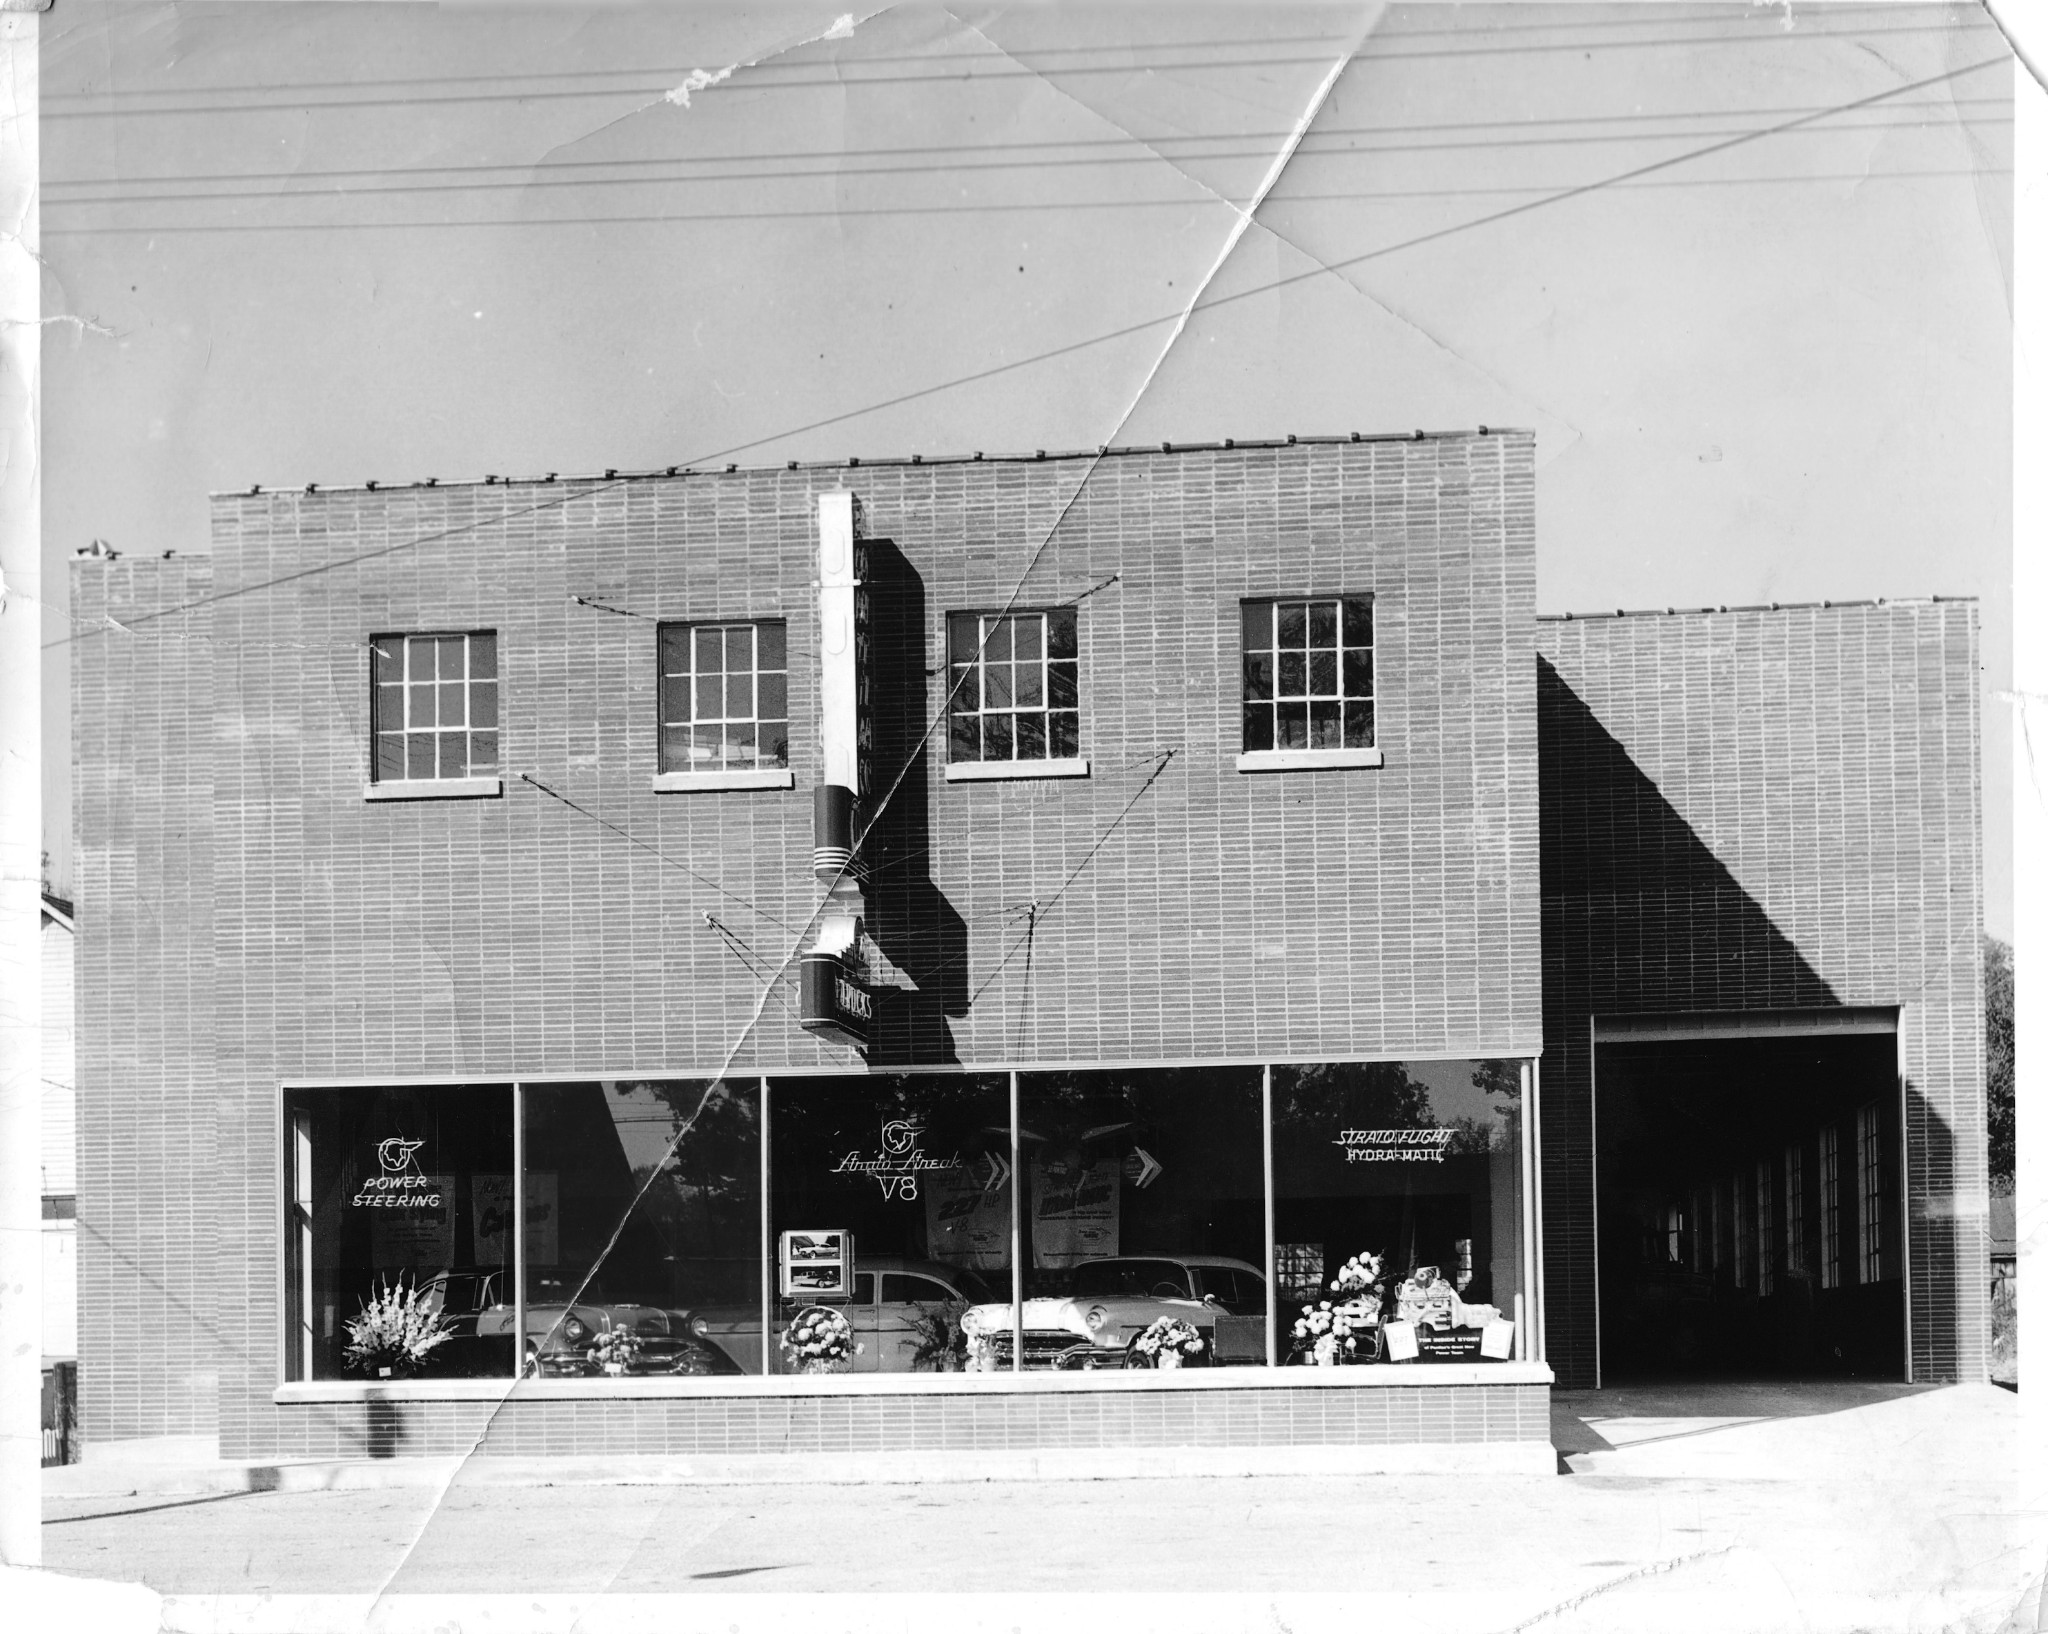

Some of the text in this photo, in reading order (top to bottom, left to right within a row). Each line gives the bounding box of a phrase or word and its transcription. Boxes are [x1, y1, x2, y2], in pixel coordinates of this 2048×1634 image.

[1332, 1128, 1459, 1146] STRATO FLIGHT
[829, 1148, 964, 1173] Strato Streak
[1346, 1148, 1446, 1162] HYDRA-MATIC
[364, 1175, 428, 1190] POWER
[876, 1175, 918, 1202] V8
[352, 1194, 441, 1207] STEERING
[937, 1194, 983, 1222] 227
